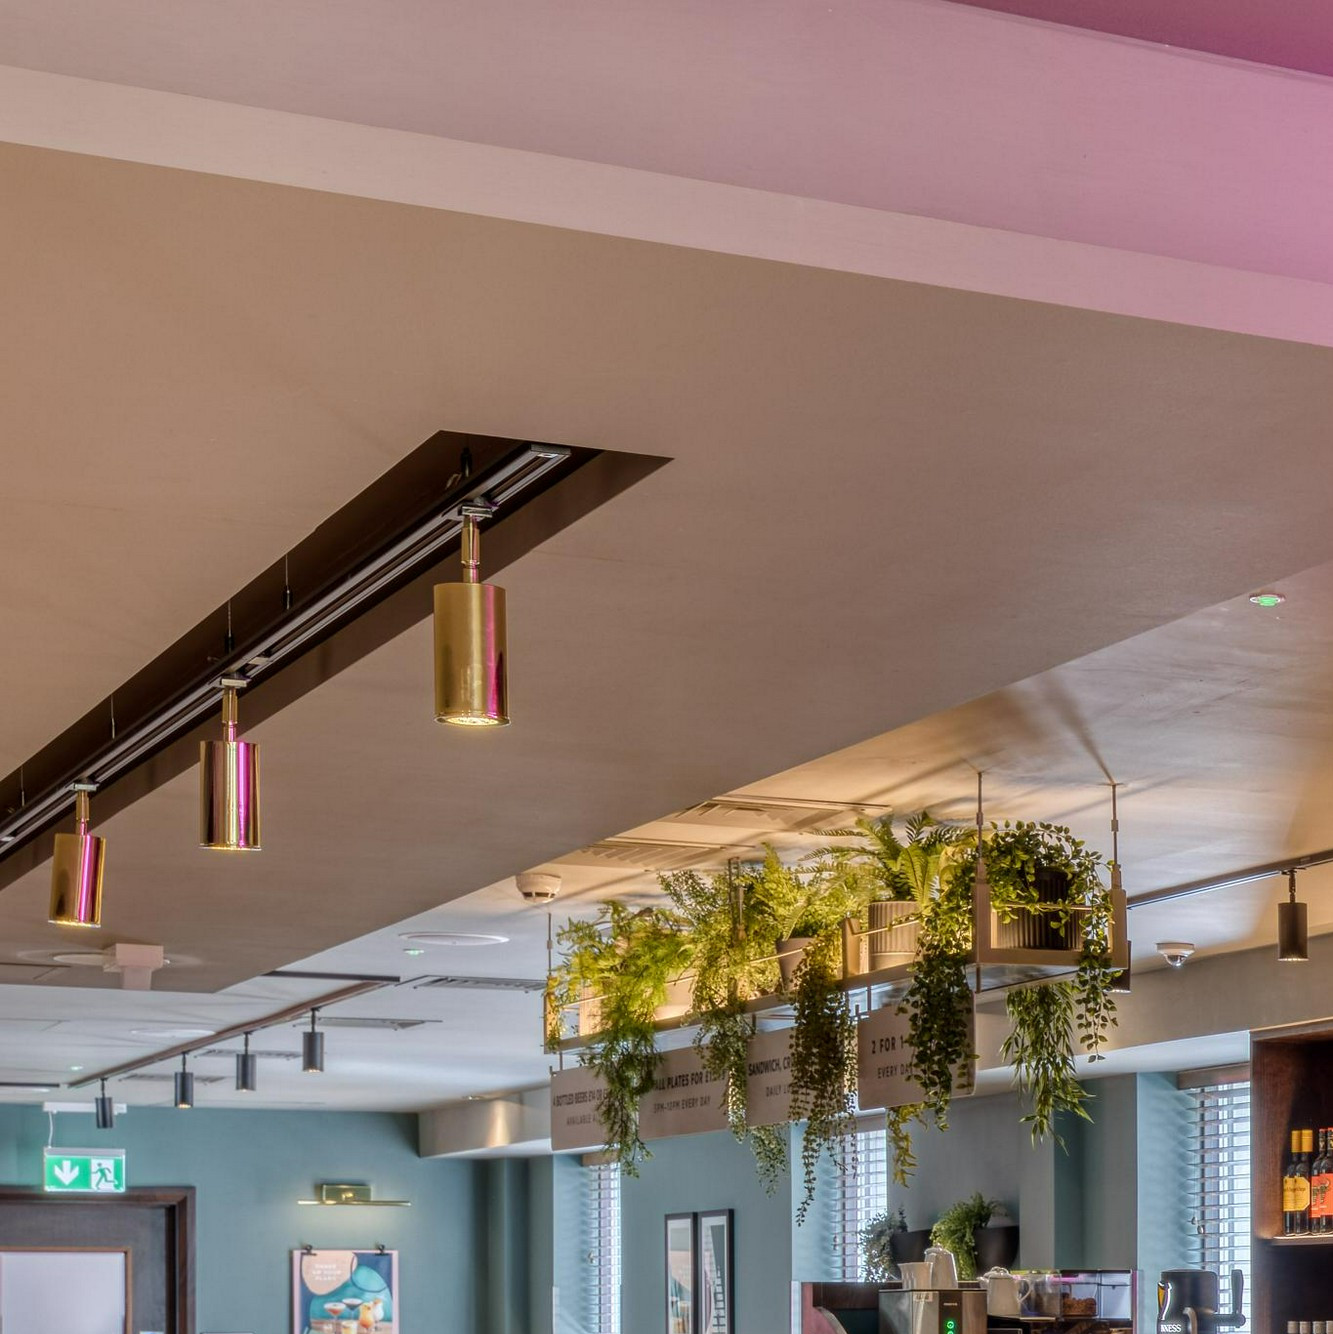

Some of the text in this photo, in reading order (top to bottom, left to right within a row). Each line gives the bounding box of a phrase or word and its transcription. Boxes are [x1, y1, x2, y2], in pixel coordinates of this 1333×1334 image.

[871, 1040, 876, 1054] 2
[880, 1038, 896, 1052] FOR
[878, 1064, 897, 1079] EVERY
[667, 1074, 689, 1089] PLATES
[691, 1072, 703, 1085] FOR
[682, 1098, 698, 1109] EVERY
